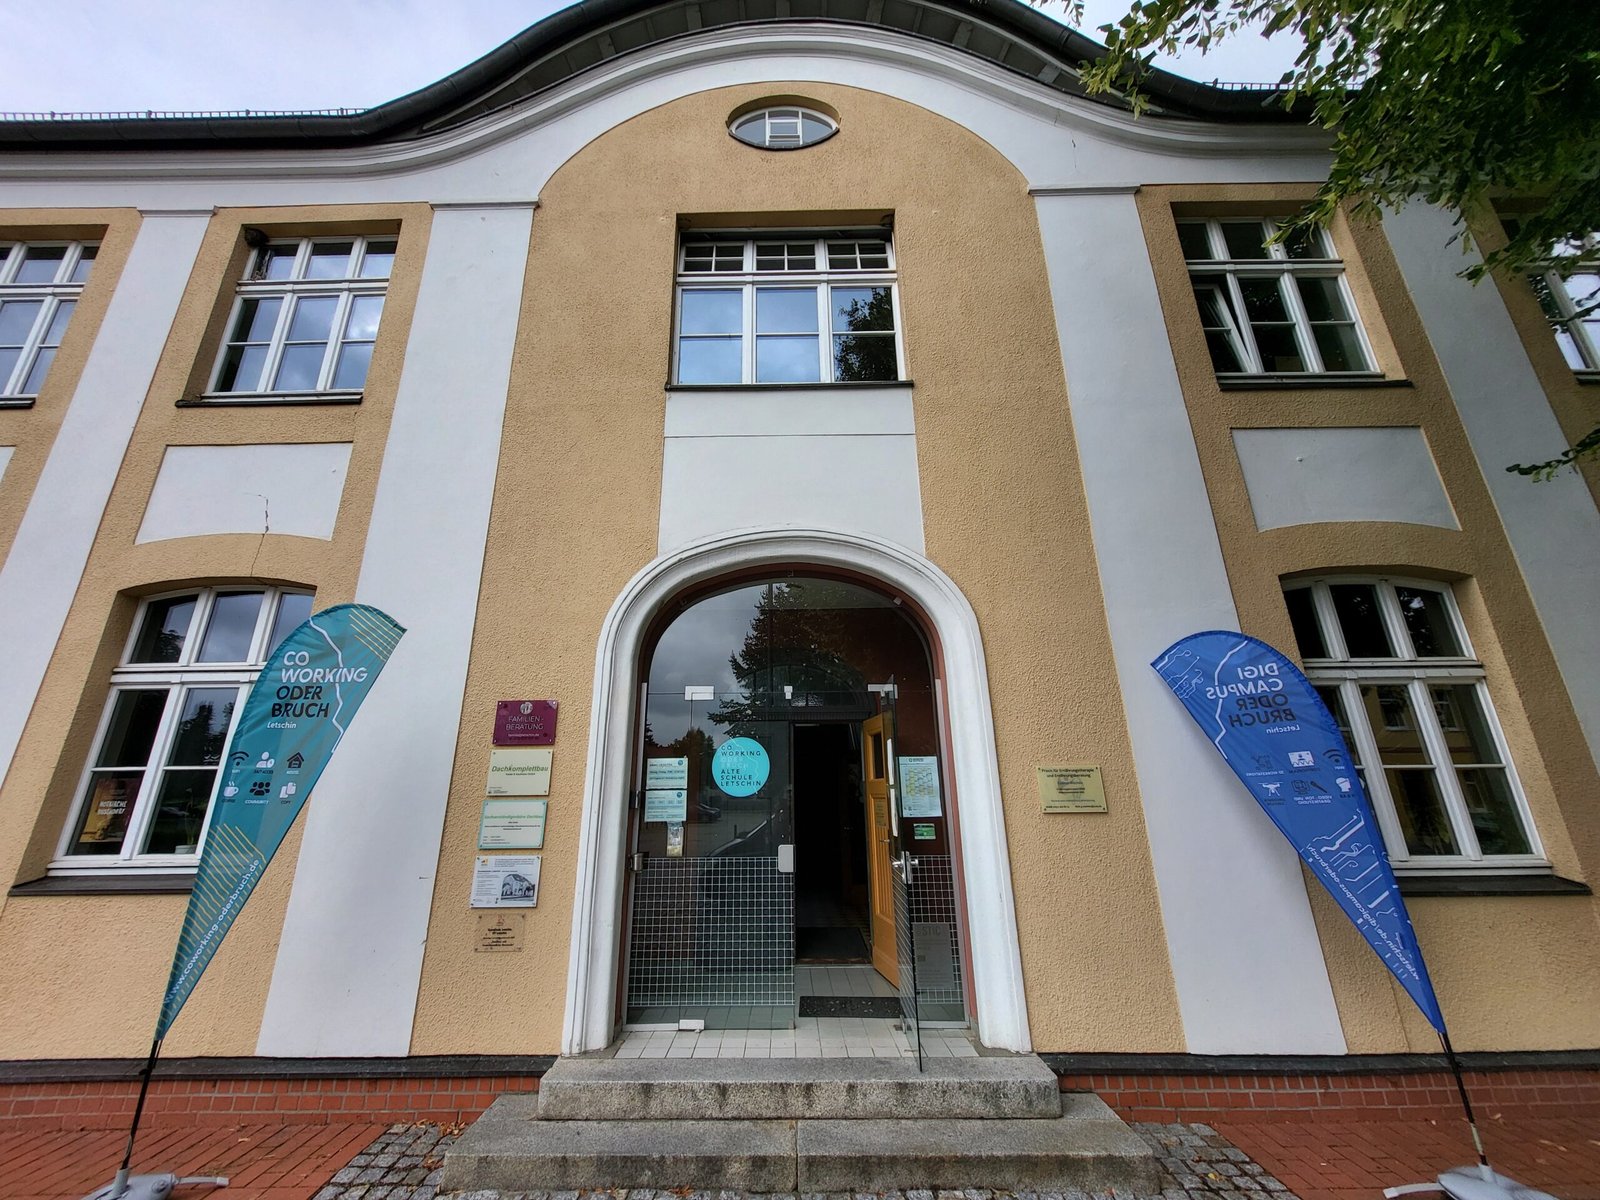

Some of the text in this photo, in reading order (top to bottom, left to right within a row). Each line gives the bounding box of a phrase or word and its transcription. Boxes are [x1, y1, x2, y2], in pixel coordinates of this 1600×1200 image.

[283, 651, 310, 666] CO
[281, 667, 369, 683] WORKING
[276, 685, 323, 700] ODER
[271, 702, 330, 718] BRUCH
[266, 721, 297, 729] Letschin
[505, 723, 544, 731] BERATUNG
[491, 765, 549, 773] Dachkomplettbau
[163, 859, 260, 1004] www.coworking-oderbruch.de
